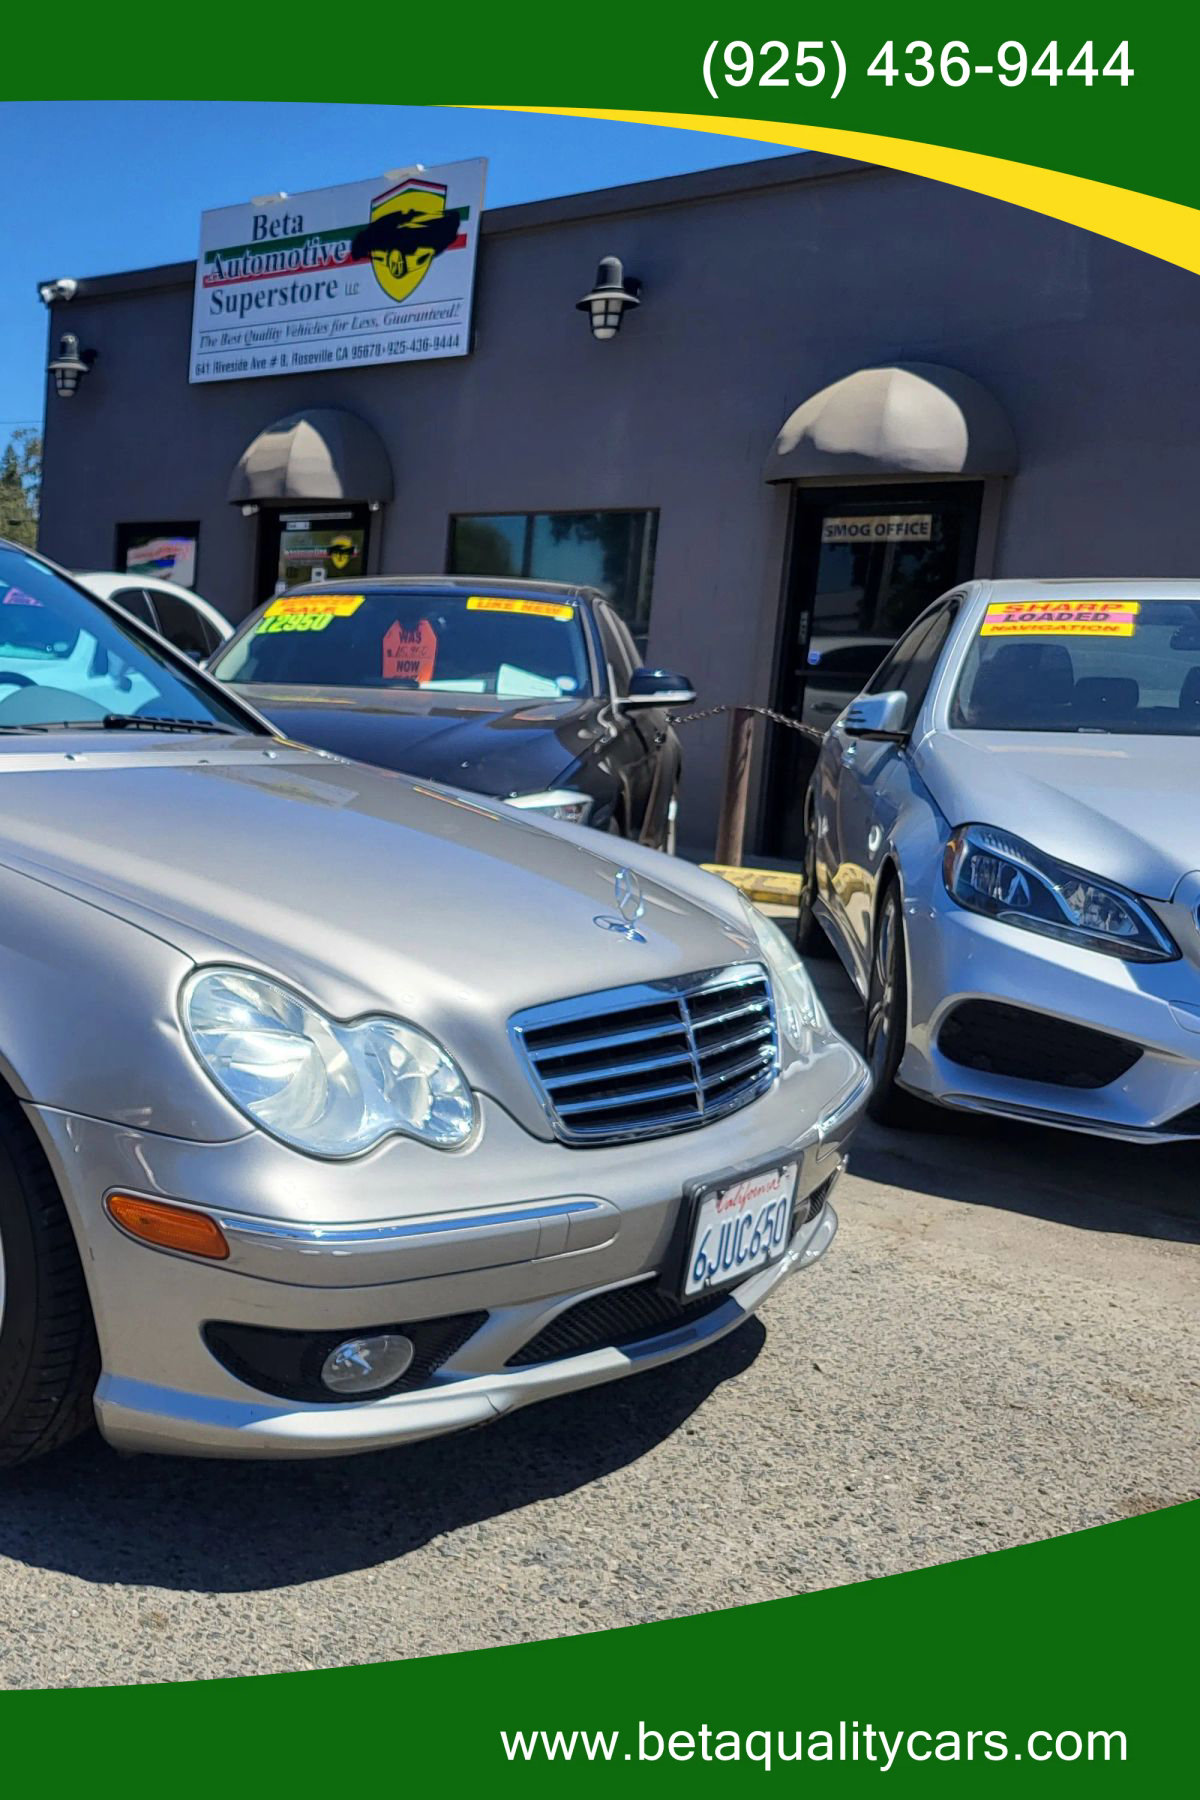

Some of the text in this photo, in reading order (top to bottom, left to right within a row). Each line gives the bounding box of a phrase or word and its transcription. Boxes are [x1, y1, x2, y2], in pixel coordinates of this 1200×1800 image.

[251, 212, 304, 241] Beta
[209, 238, 348, 280] Automotive
[209, 279, 339, 319] Superstore
[344, 282, 360, 296] LLC
[199, 335, 218, 349] The
[220, 332, 242, 346] Best
[244, 327, 283, 347] Quality
[285, 320, 328, 337] Vehicles
[328, 320, 350, 337] for
[383, 303, 463, 326] Guaranteed!
[195, 361, 211, 376] 641
[250, 357, 267, 370] Ave
[291, 349, 333, 366] Roseville
[335, 347, 348, 361] CA
[823, 521, 929, 538] SMOG OFFICE
[1002, 612, 1112, 623] LOADED
[1003, 602, 1124, 614] SHARP
[255, 613, 336, 635] 12950
[990, 624, 1121, 633] NAVIGATION
[398, 631, 422, 645] WAS
[396, 660, 421, 673] NOW
[715, 1176, 781, 1214] California
[692, 1196, 787, 1281] 6JUC650
